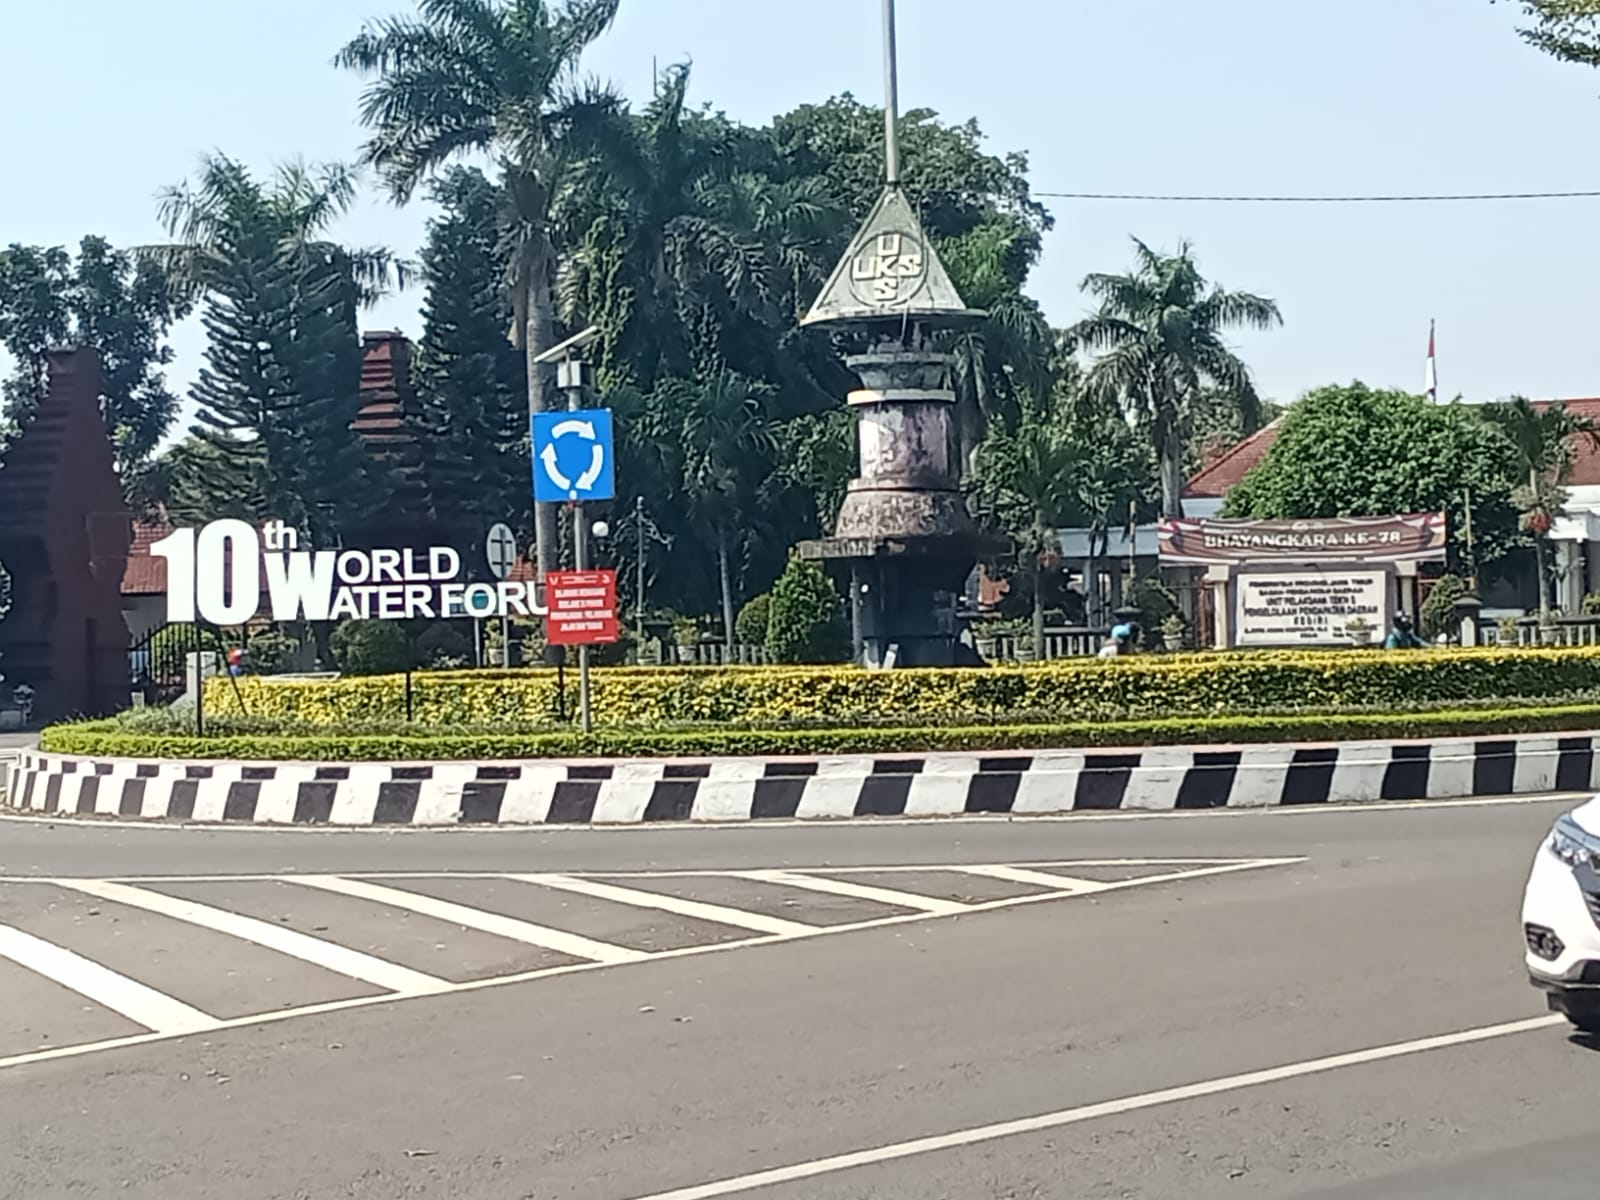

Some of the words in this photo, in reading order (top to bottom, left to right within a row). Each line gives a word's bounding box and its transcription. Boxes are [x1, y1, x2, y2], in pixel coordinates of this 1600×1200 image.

[1205, 533, 1338, 548] BHAYANGKARA
[1344, 530, 1401, 546] KE-78
[440, 581, 549, 619] FORU
[1329, 595, 1356, 605] TEKNS
